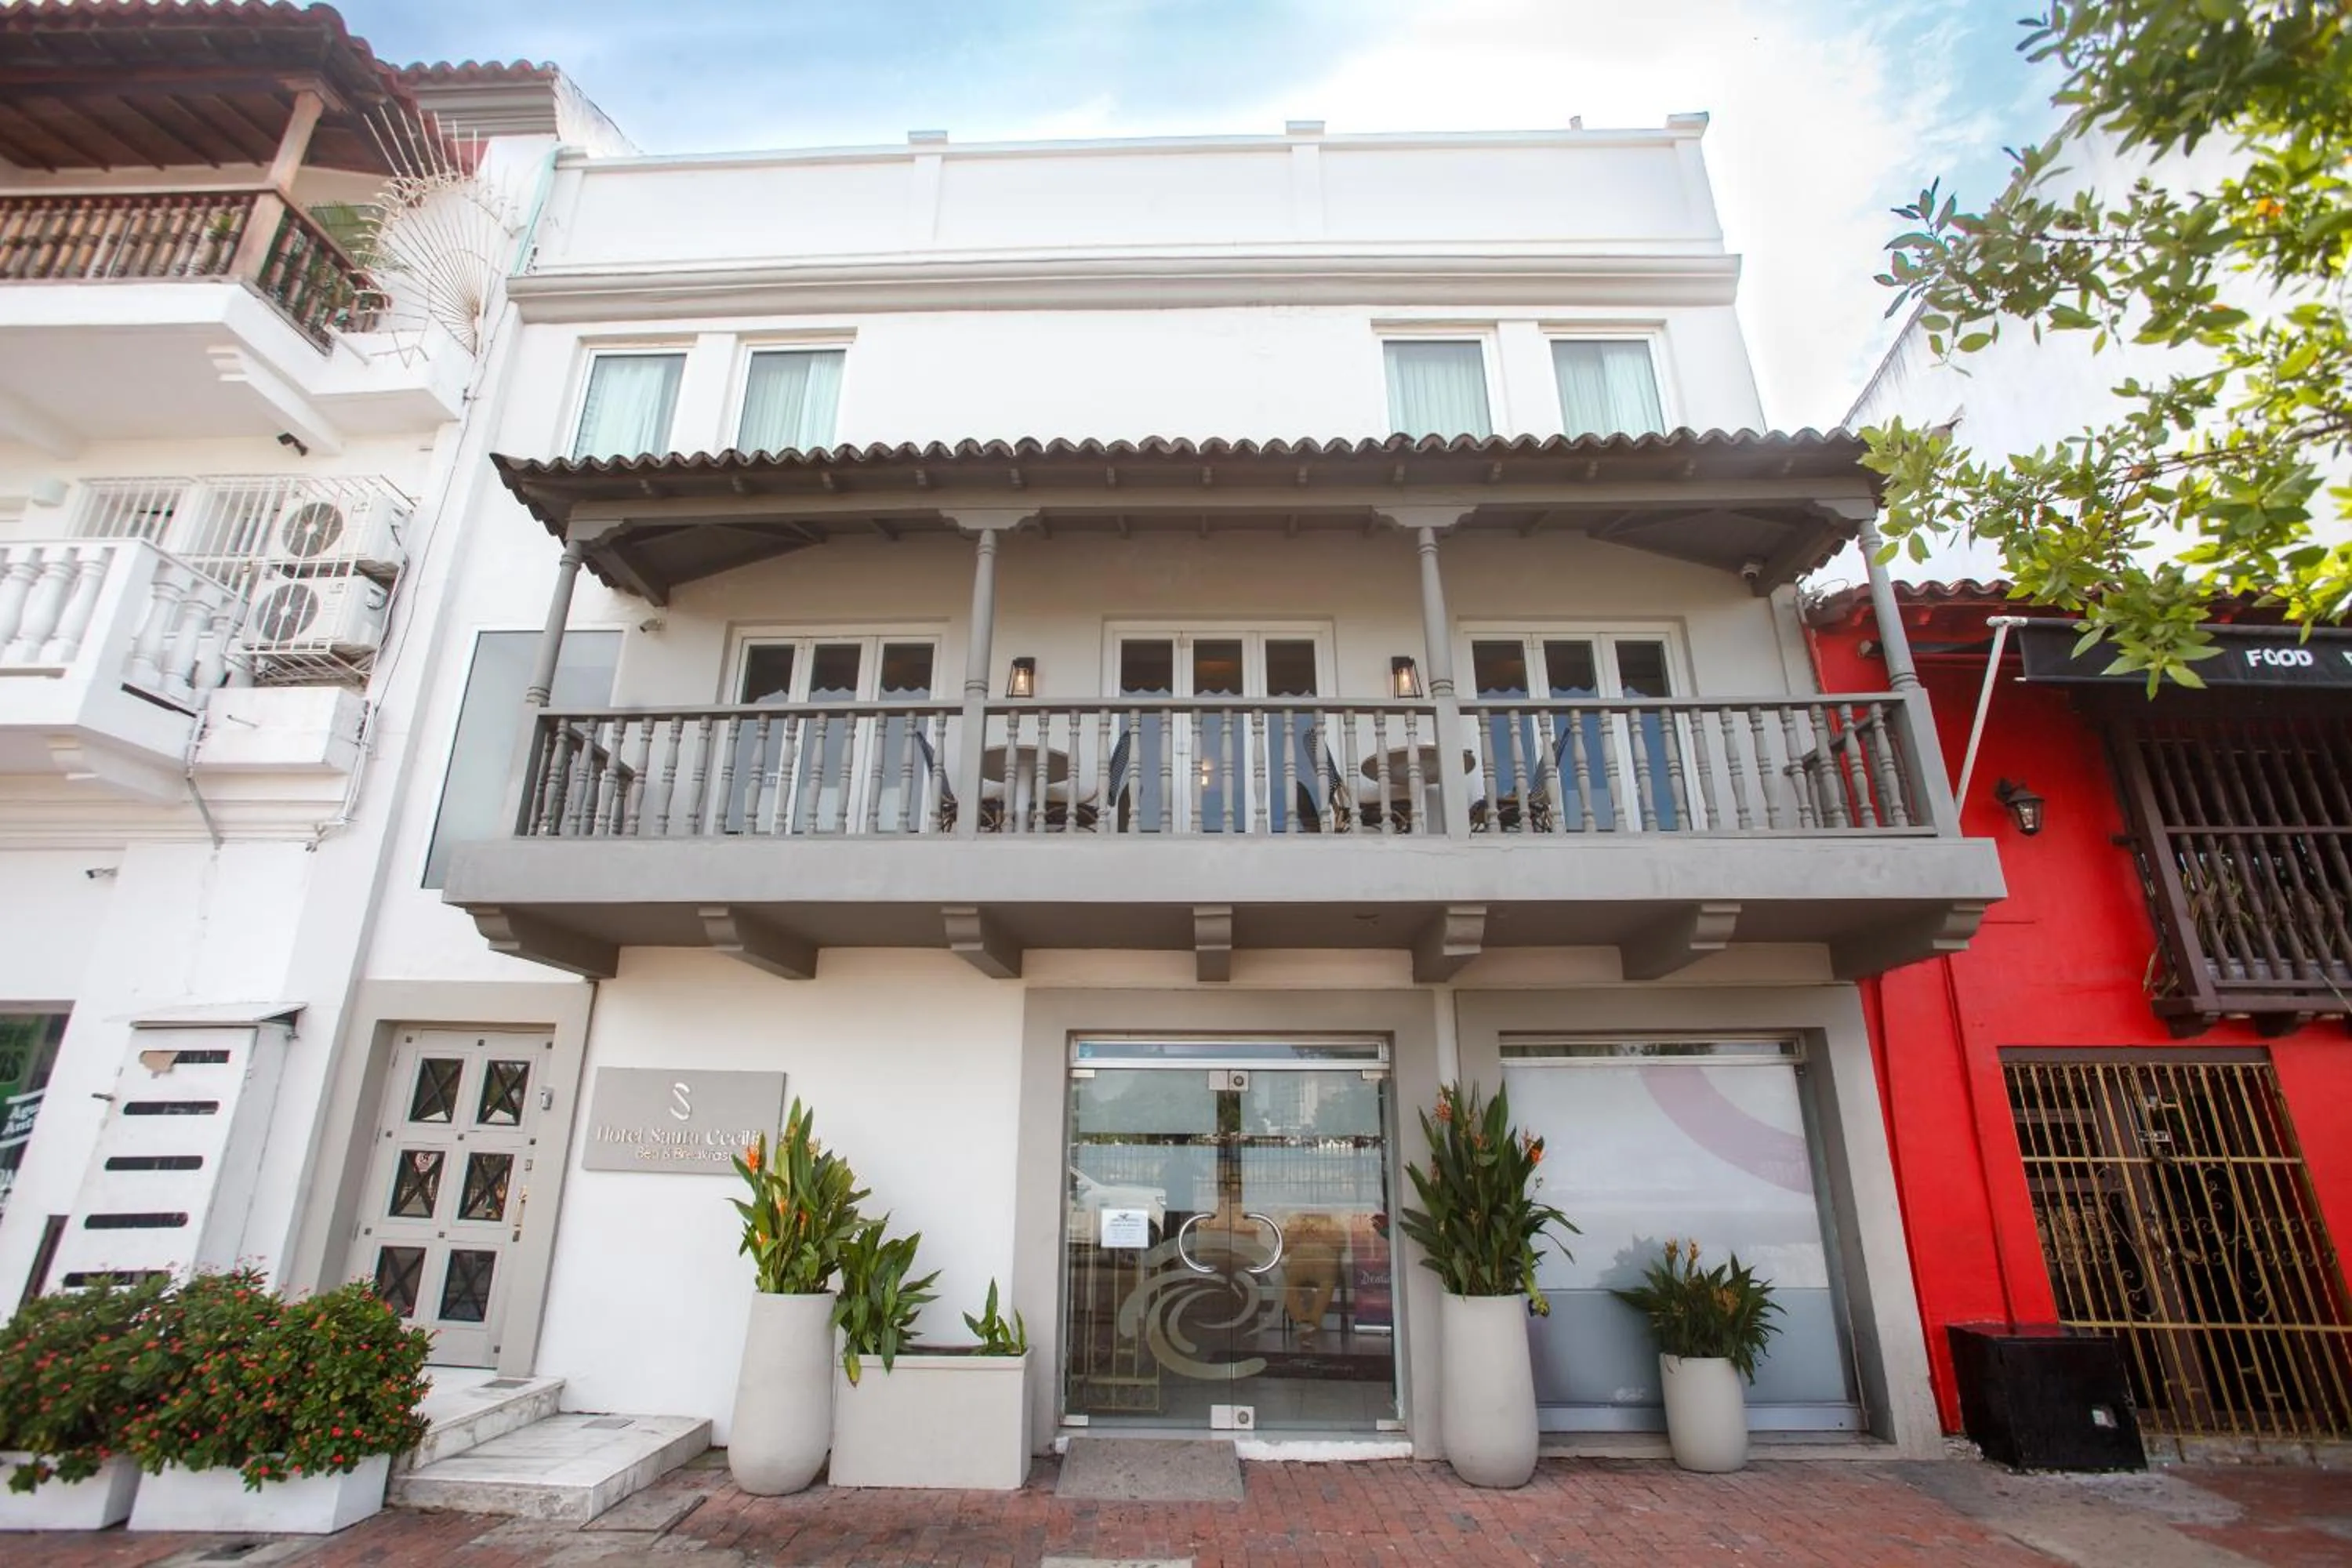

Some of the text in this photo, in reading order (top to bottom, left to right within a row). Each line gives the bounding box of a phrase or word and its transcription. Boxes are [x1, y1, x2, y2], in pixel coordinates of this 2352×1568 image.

[2245, 648, 2314, 666] FOOD
[596, 1125, 644, 1143] Hotel
[650, 1127, 700, 1145] Santa
